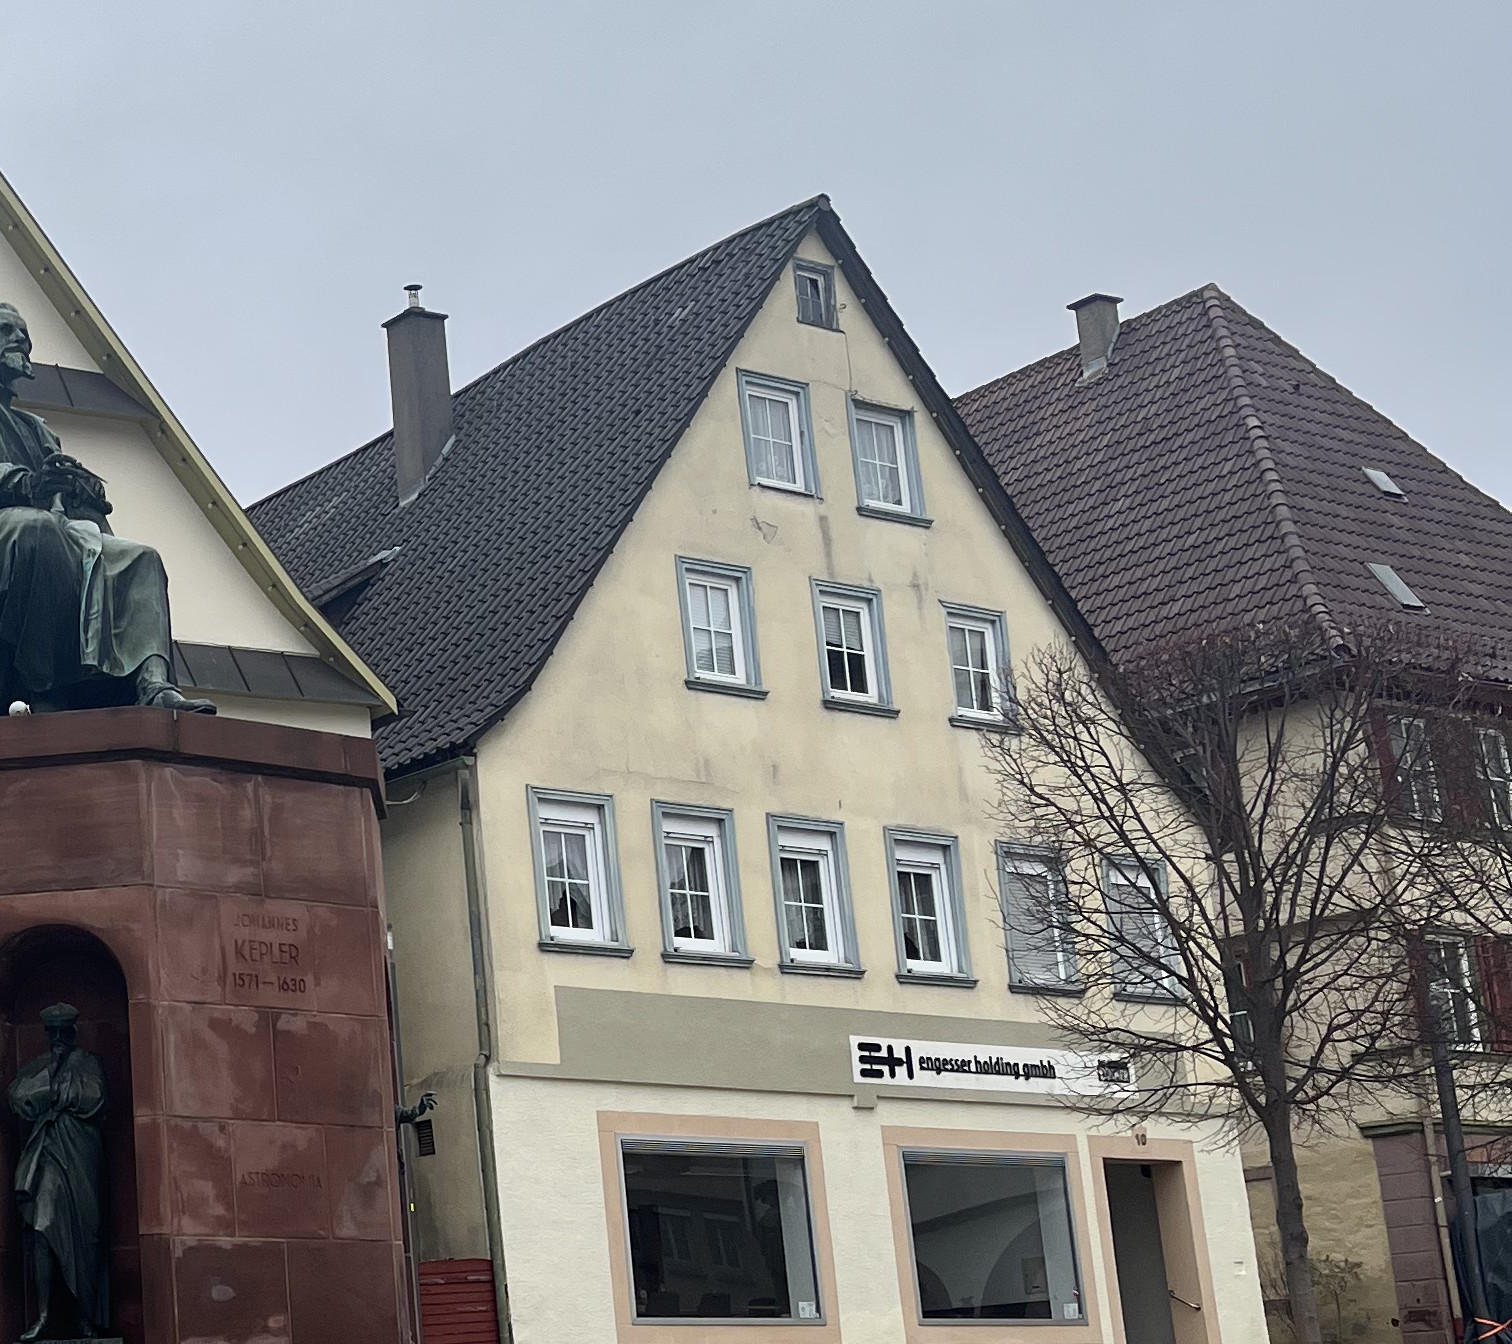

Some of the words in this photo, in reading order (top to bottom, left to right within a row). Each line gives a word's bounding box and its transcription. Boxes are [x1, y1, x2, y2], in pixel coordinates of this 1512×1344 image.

[234, 938, 299, 967] KEPLER
[918, 1055, 972, 1076] engesser
[973, 1054, 1021, 1081] holding
[1022, 1059, 1057, 1081] gmbh
[1134, 1133, 1147, 1146] 10
